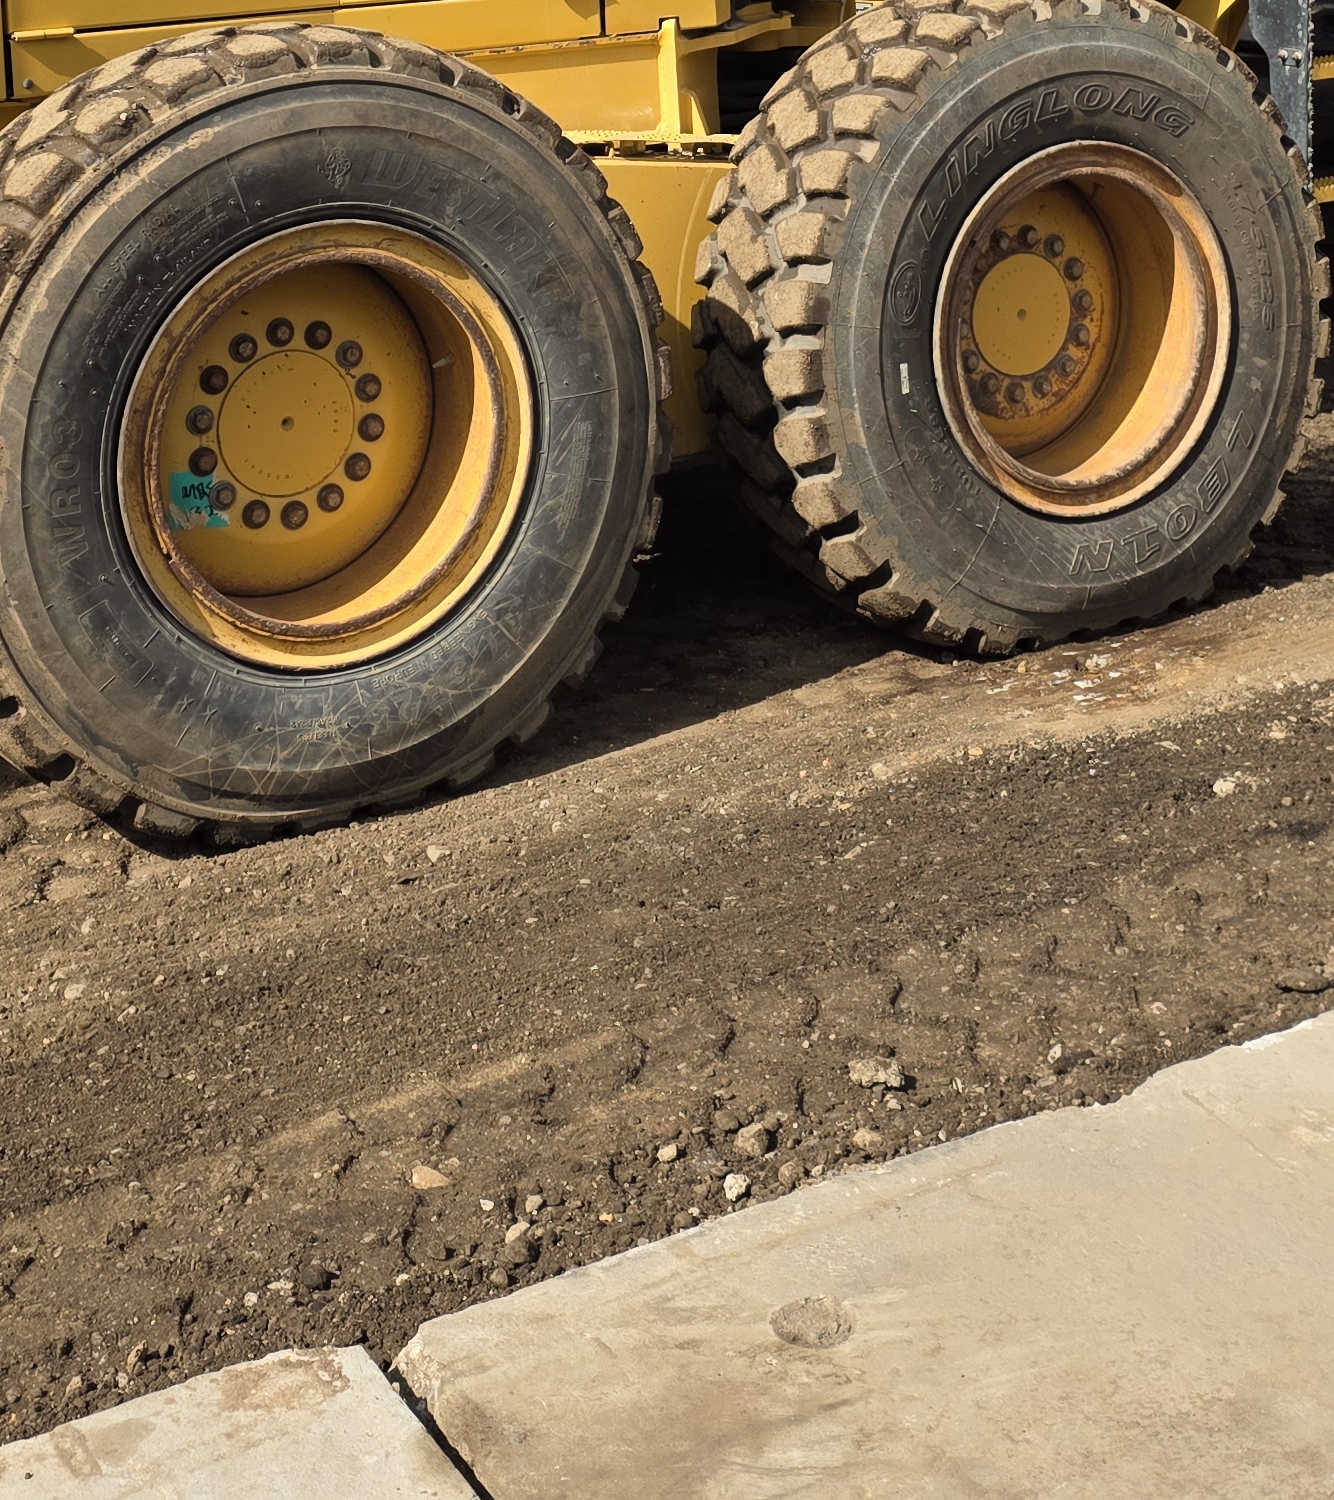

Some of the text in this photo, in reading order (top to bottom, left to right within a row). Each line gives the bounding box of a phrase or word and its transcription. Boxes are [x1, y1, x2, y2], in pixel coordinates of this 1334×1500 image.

[917, 81, 1197, 241] LINGLONG
[109, 238, 142, 273] STEEL
[139, 203, 181, 239] RADIAL
[361, 147, 575, 308] WESTLAKE
[371, 663, 418, 690] EUROPE
